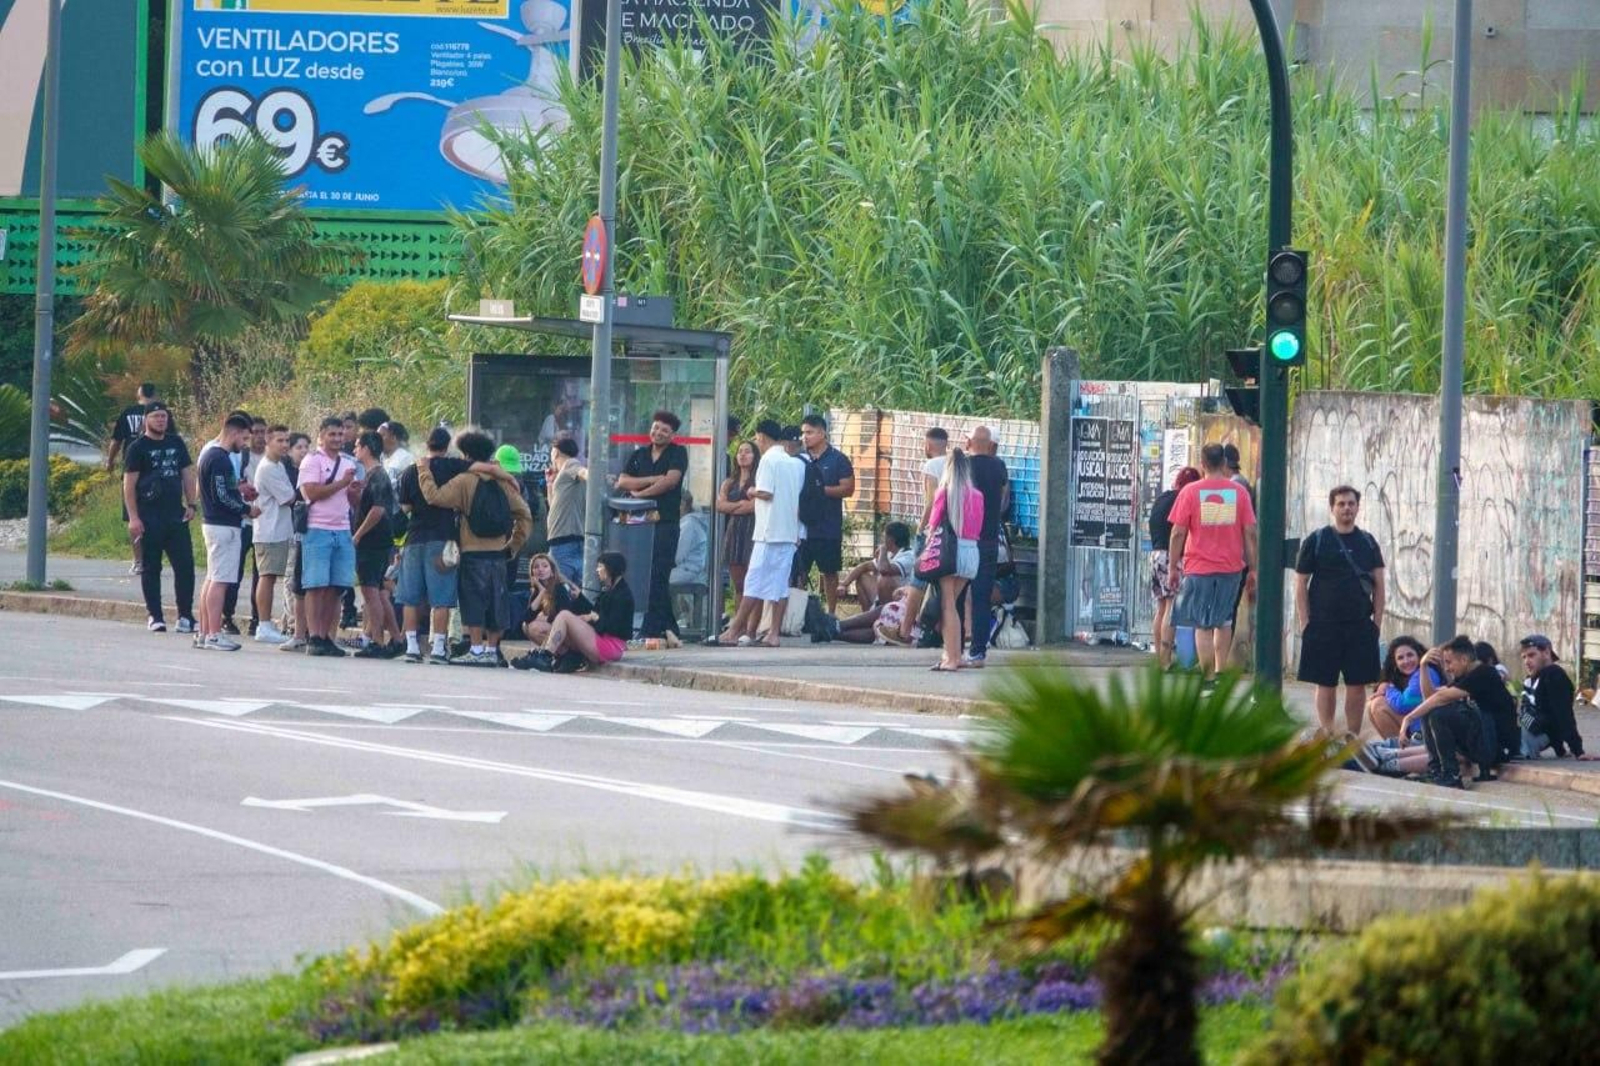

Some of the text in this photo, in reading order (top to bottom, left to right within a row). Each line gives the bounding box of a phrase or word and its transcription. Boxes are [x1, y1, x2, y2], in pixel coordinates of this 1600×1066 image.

[197, 27, 400, 54] VENTILADORES
[196, 56, 365, 81] con LUZ desde
[354, 192, 381, 202] JUNIO
[533, 443, 550, 453] LA
